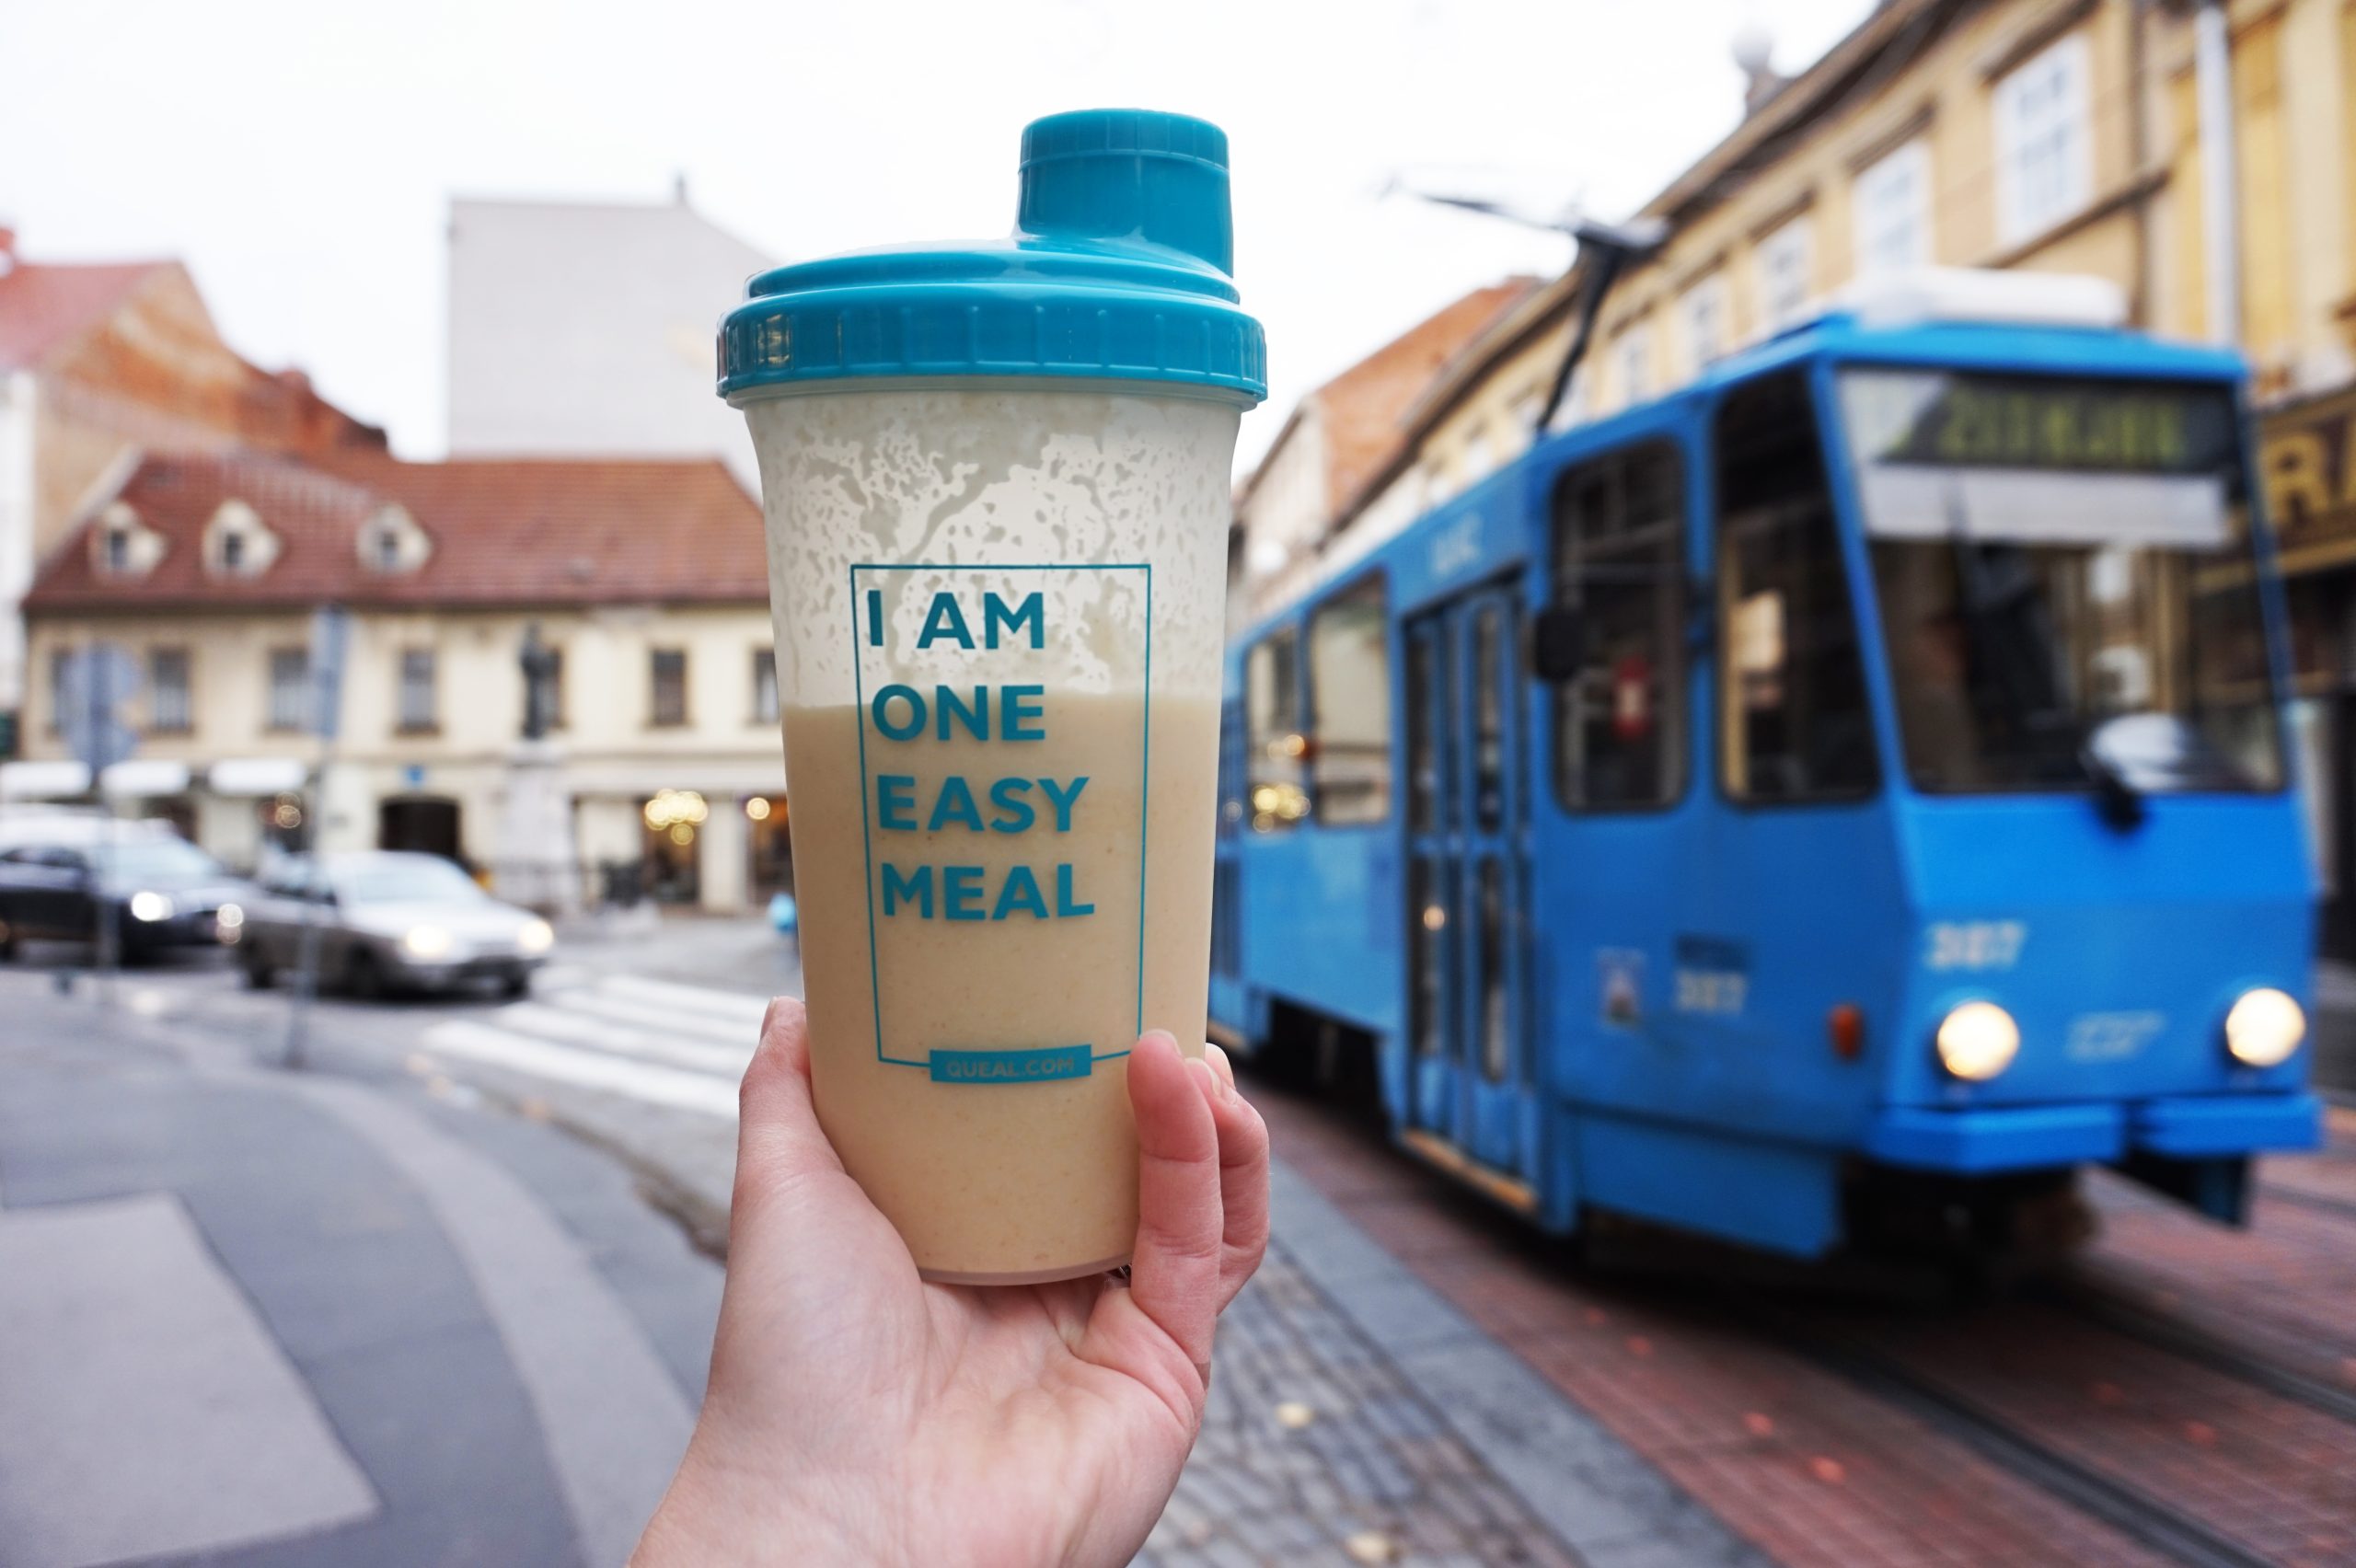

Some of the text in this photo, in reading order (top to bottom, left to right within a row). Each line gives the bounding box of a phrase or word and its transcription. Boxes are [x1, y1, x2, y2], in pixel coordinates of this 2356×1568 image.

[866, 589, 1045, 651] I AM
[872, 684, 1045, 742] ONE
[877, 775, 1090, 834] EASY
[882, 863, 1095, 920] MEAL
[946, 1058, 1074, 1078] QUEAL.COM
